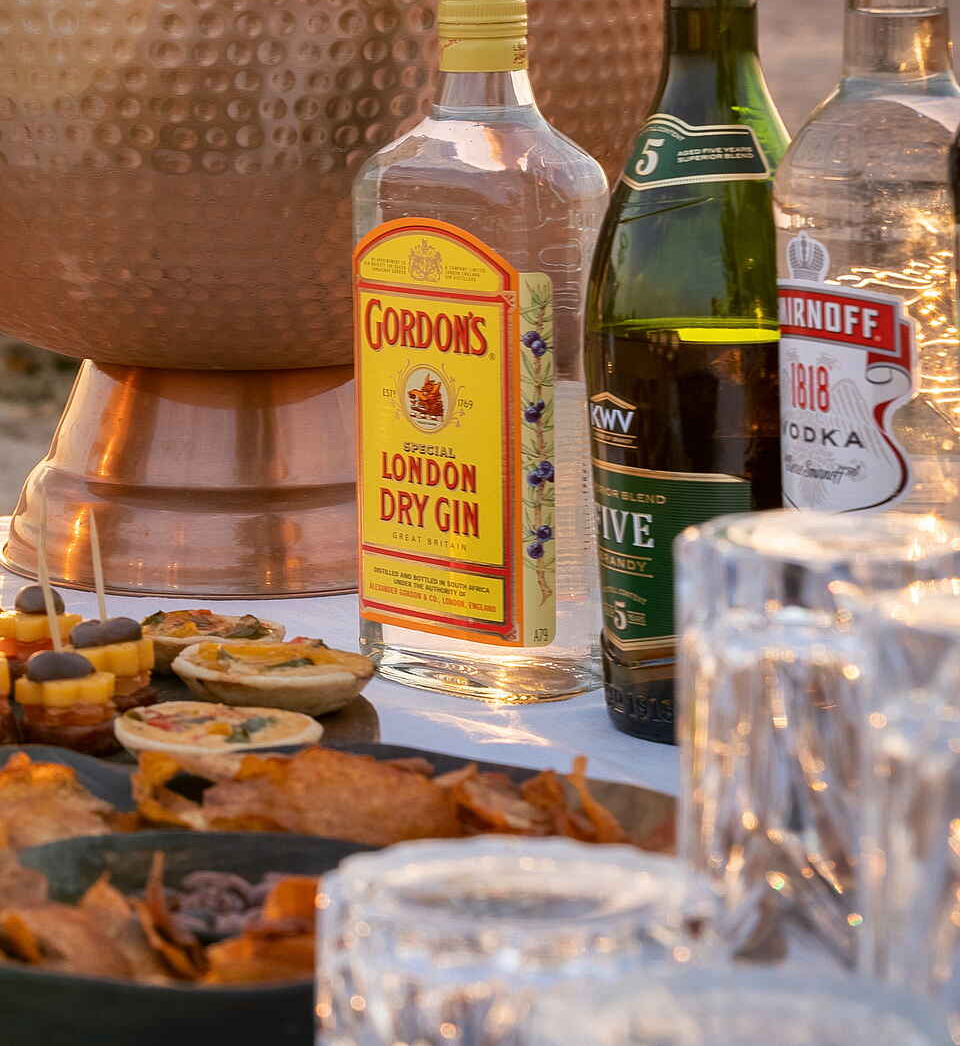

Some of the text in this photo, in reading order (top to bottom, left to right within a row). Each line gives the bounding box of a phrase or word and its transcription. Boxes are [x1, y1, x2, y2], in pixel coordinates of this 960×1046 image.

[634, 138, 666, 176] 5
[364, 298, 488, 356] GORDON'S
[791, 361, 831, 413] 1818
[590, 403, 634, 434] KWV
[403, 441, 456, 459] SPECIAL
[381, 451, 478, 495] LONDON
[623, 490, 667, 505] BLEND
[379, 487, 480, 539] DRY GIN
[392, 531, 469, 553] GREAT BRITAIN
[393, 578, 467, 597] UNDER THE AUTHORITY OF
[399, 571, 413, 581] AND
[413, 572, 439, 585] BOTTLED
[438, 578, 446, 586] IN
[447, 579, 468, 589] SOUTH
[468, 584, 490, 594] AFRICA
[468, 601, 497, 613] ENGLAND
[614, 600, 629, 630] 5
